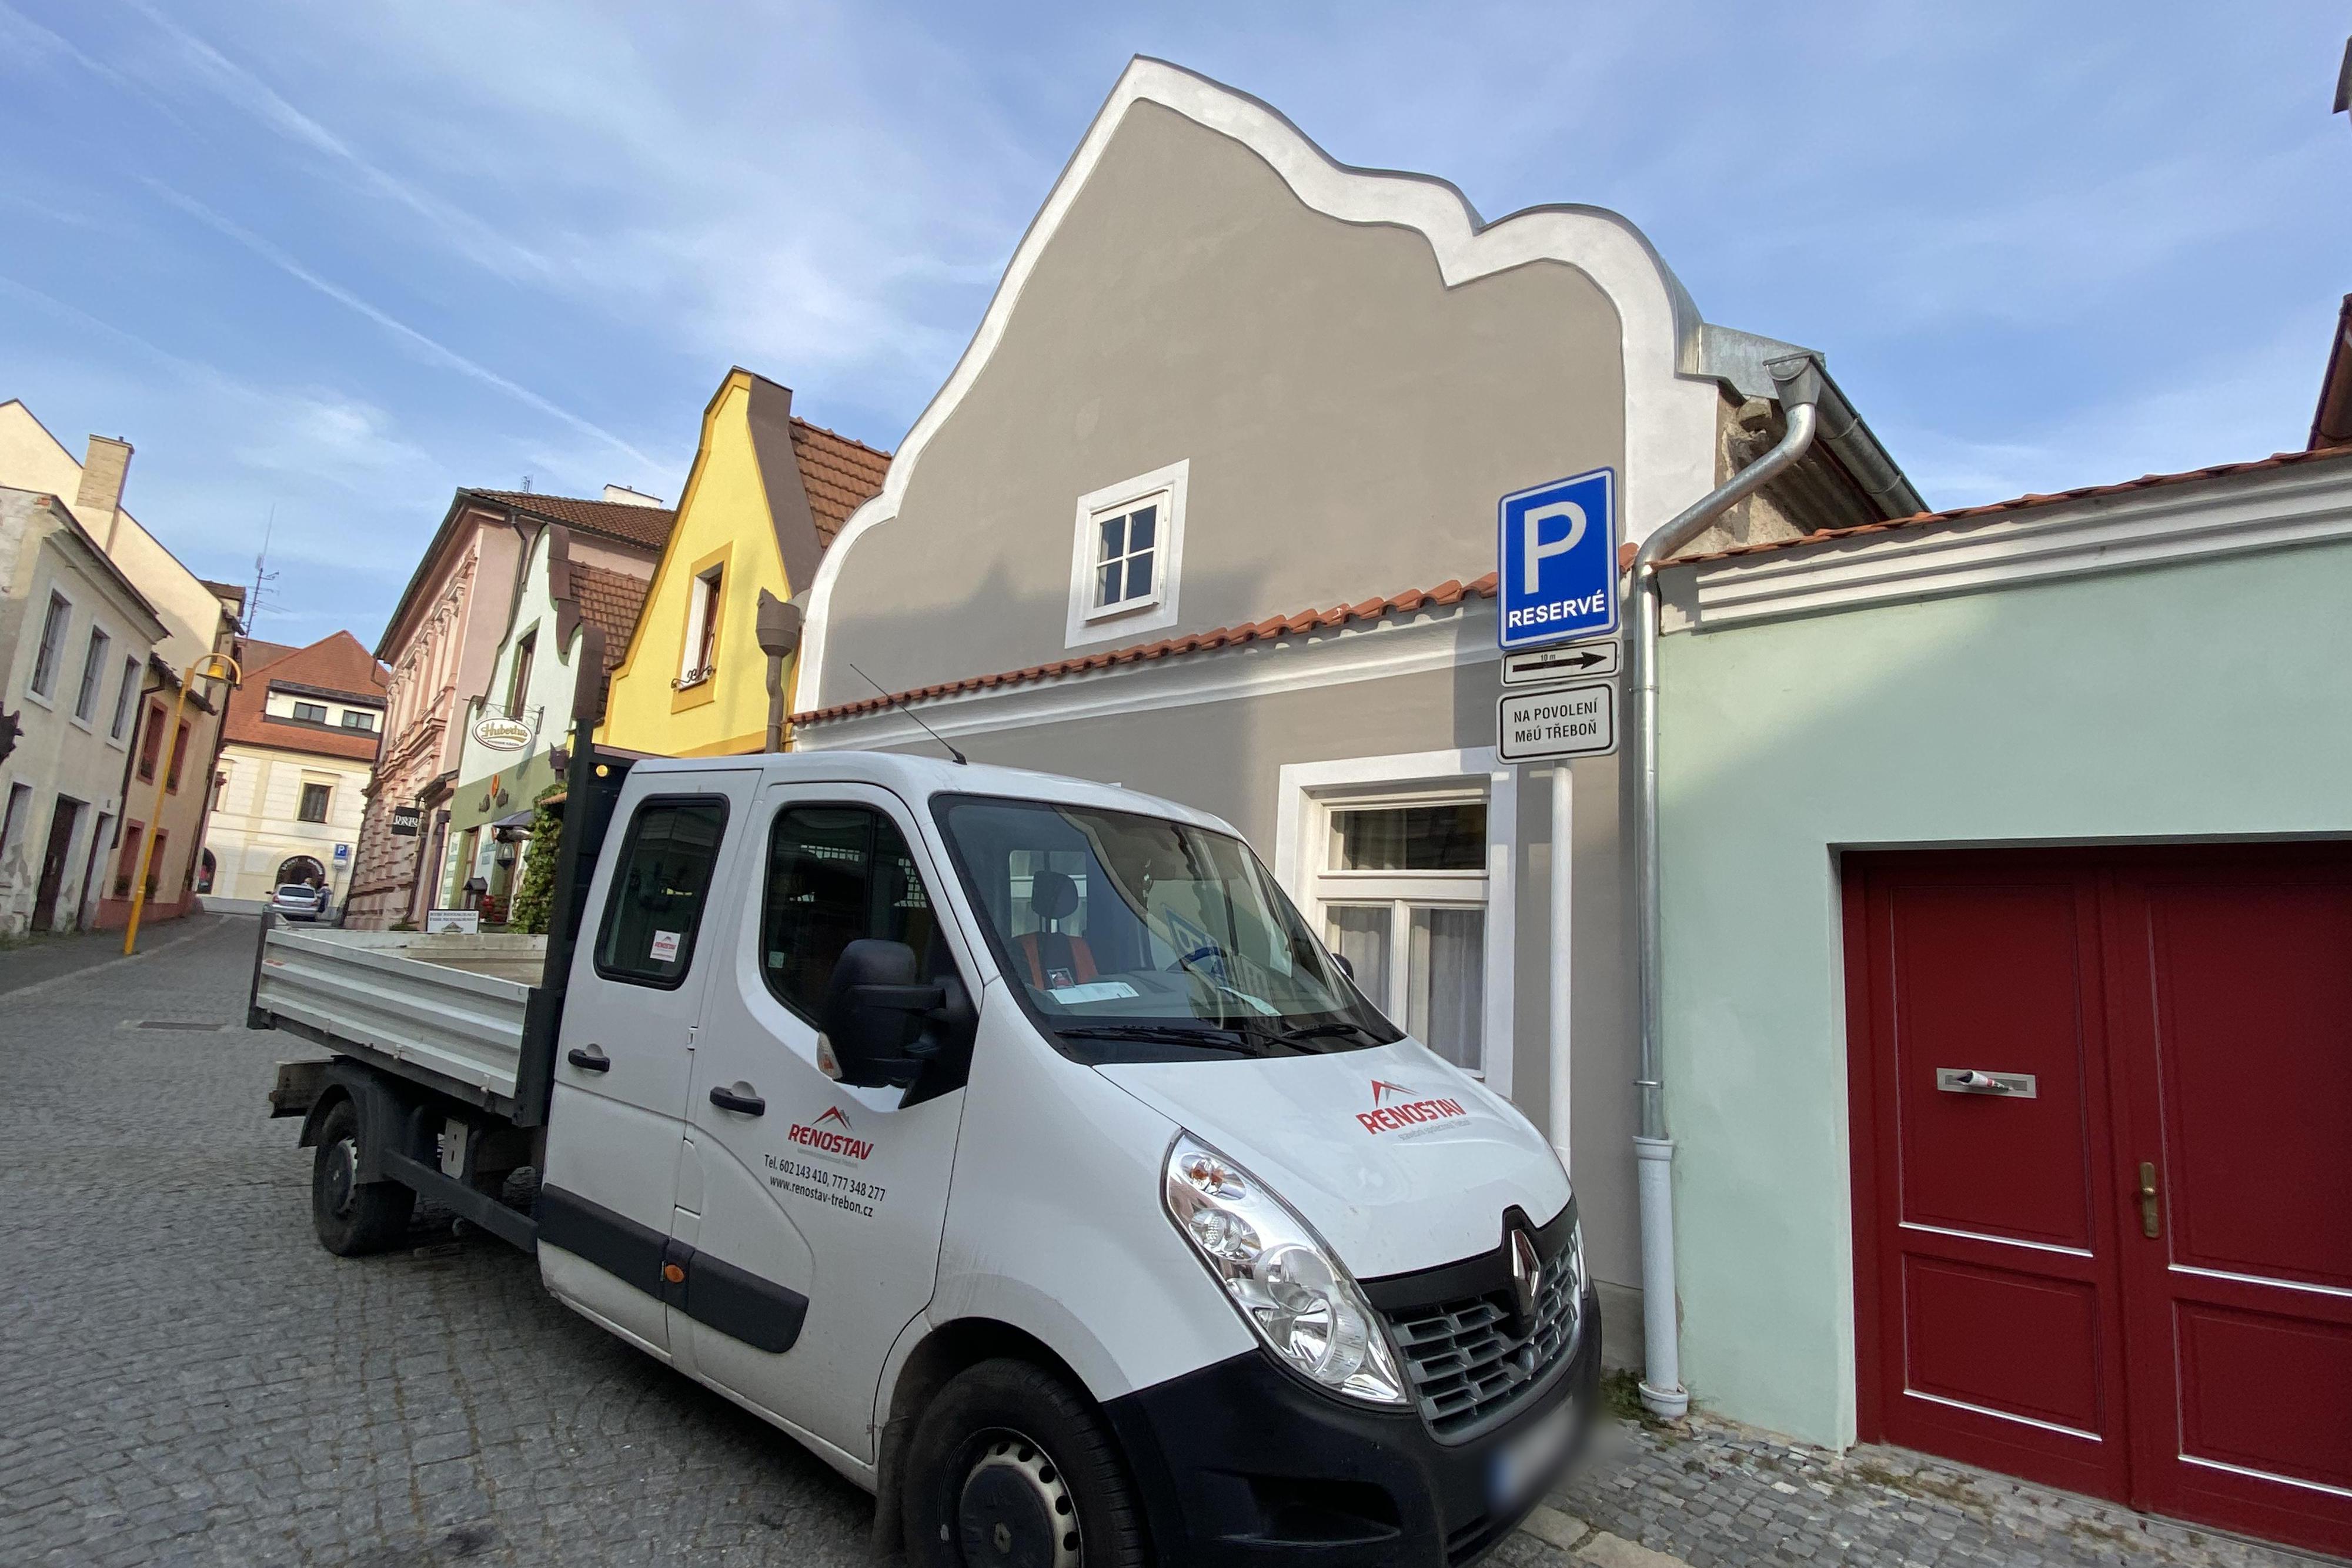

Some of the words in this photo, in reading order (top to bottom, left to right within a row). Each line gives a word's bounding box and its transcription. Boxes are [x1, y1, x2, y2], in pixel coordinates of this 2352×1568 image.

[1524, 501, 1587, 596] P
[1508, 589, 1606, 628] RESERVÉ
[1514, 710, 1531, 723] NA
[1534, 697, 1598, 720] POVOLENÍ
[480, 721, 528, 737] Hubertus
[1545, 718, 1596, 740] TŘEBOŇ
[338, 845, 345, 854] P
[1355, 1098, 1467, 1135] RENOSTAV
[787, 1123, 874, 1160] RENOSTAV
[765, 1154, 778, 1170] Tel.
[780, 1159, 794, 1175] 602
[796, 1164, 811, 1179] 143
[812, 1169, 830, 1188] 410,
[833, 1174, 848, 1191] 777
[849, 1179, 866, 1196] 348
[868, 1185, 886, 1202] 277
[770, 1176, 874, 1218] www.renostav-trebon.cz
